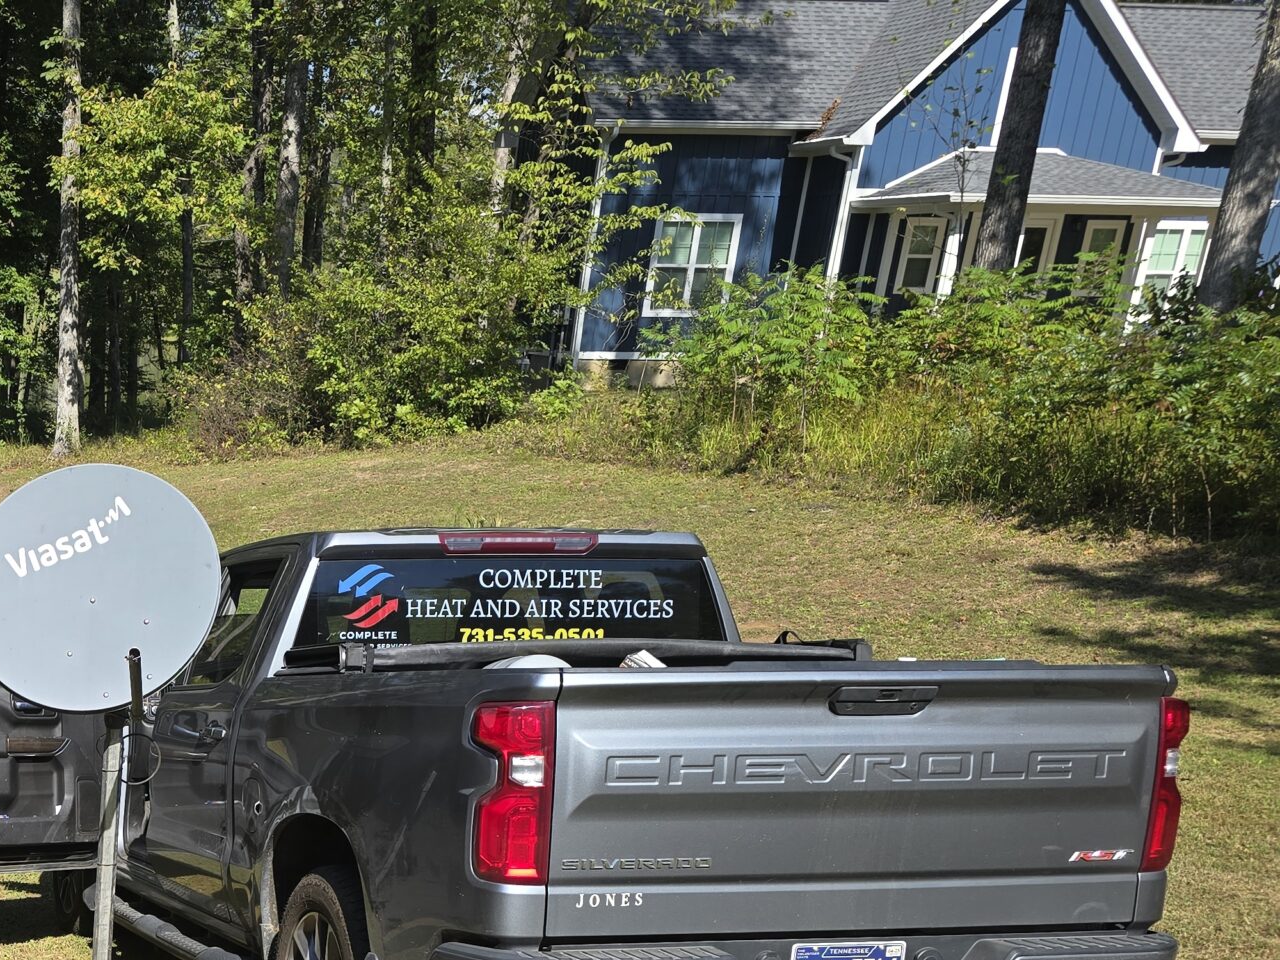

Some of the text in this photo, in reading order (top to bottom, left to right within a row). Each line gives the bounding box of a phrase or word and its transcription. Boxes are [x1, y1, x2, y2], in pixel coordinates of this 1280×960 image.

[4, 517, 109, 578] Viasat
[478, 568, 603, 589] COMPLETE
[405, 598, 675, 619] HEAT AND AIR SERVICES
[339, 630, 398, 640] COMPLETE
[605, 749, 1126, 786] CHEVROLET
[561, 857, 713, 870] SILVERADO
[575, 892, 643, 908] JONES
